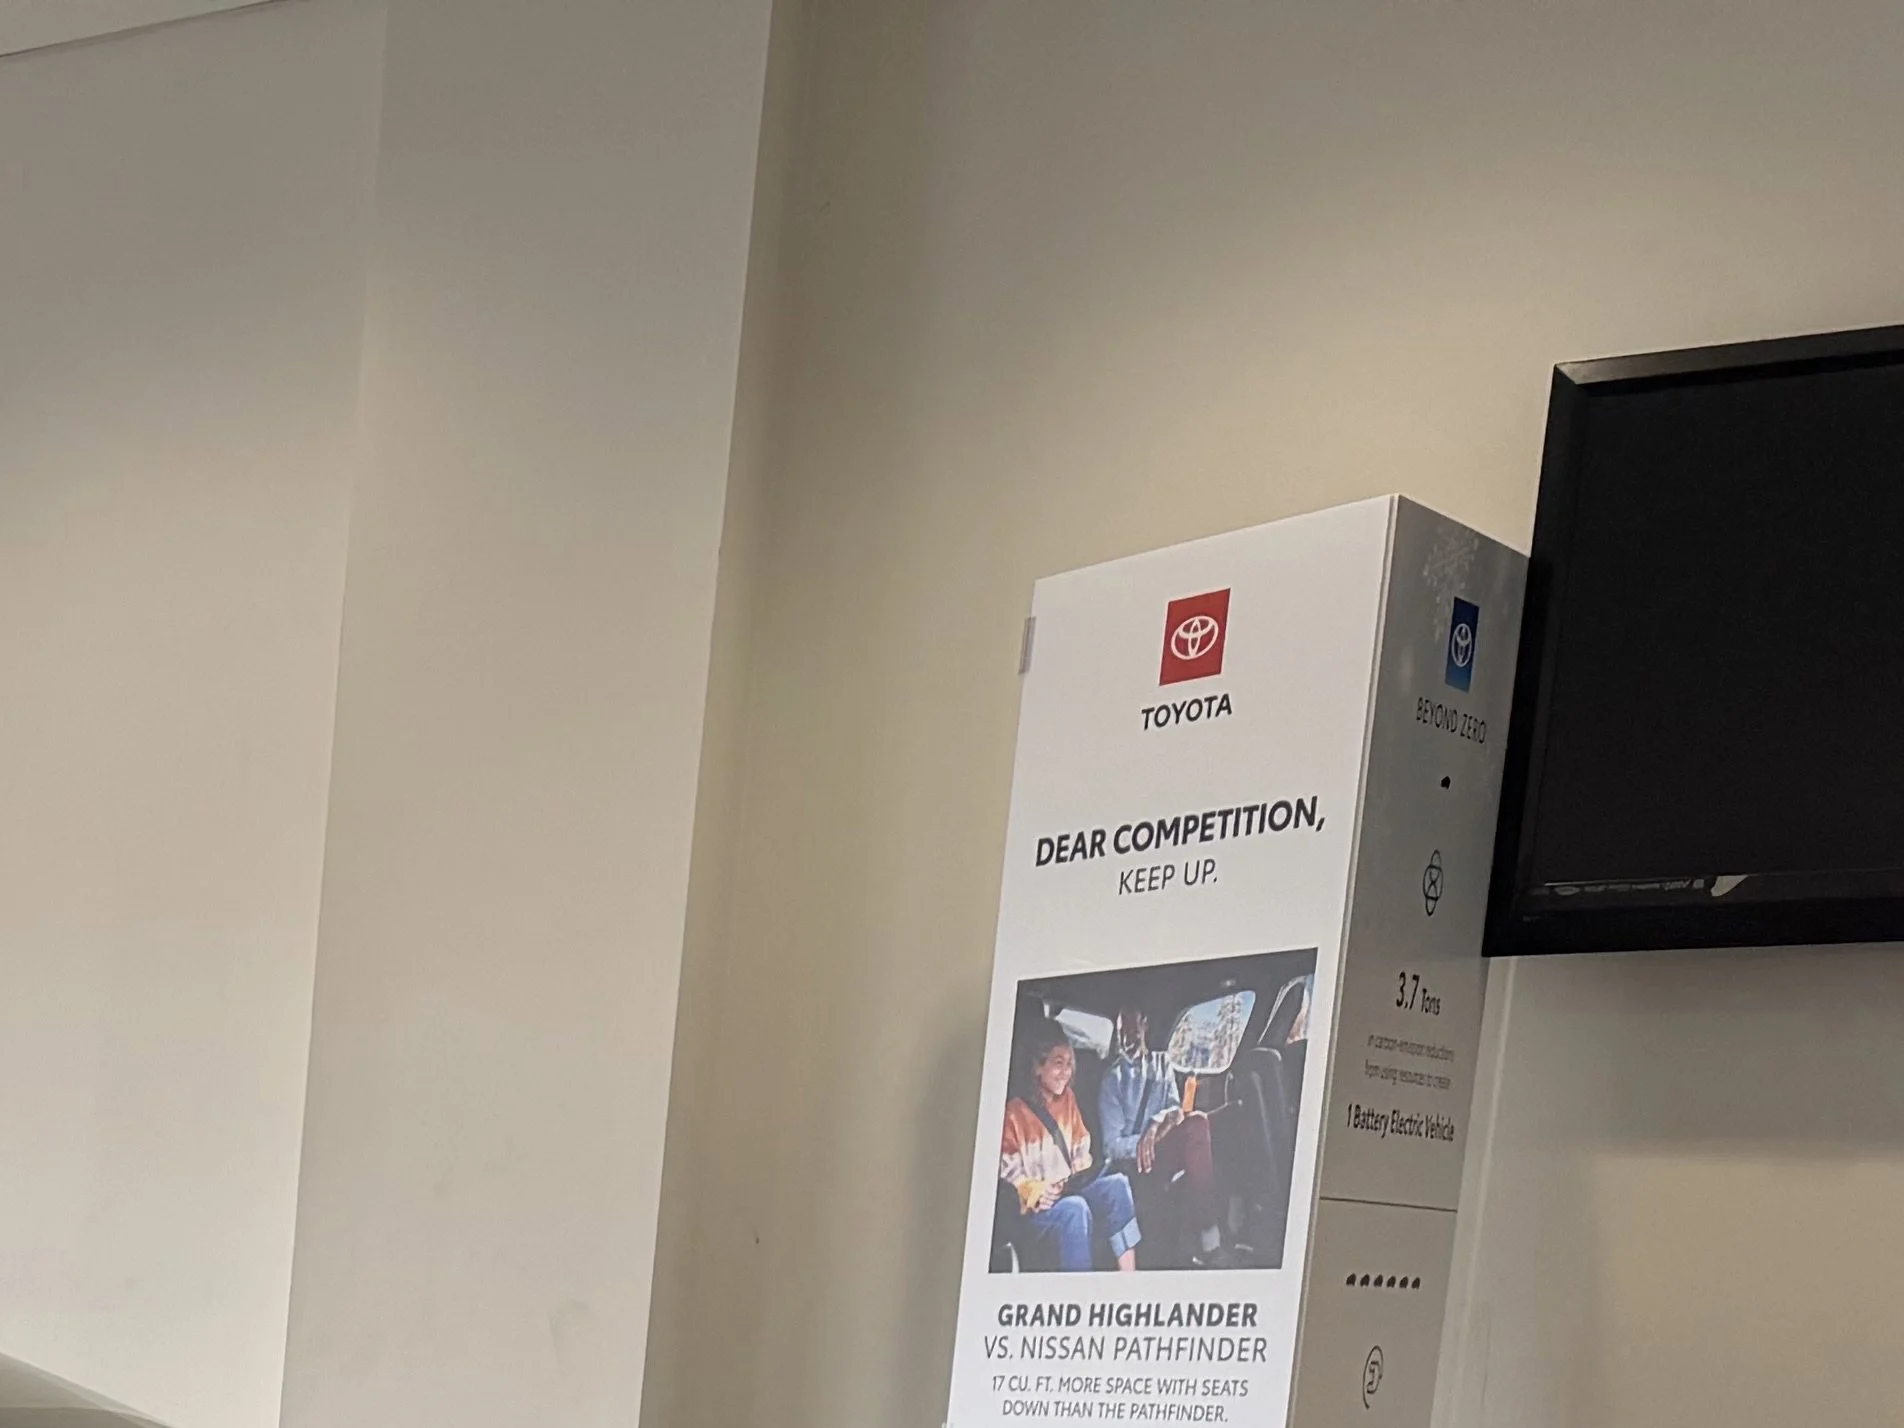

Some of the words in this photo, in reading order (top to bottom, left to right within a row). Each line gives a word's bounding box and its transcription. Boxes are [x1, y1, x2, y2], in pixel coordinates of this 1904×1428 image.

[1141, 693, 1233, 731] TOYOTA
[1416, 696, 1458, 734] BEYOND
[1460, 709, 1487, 745] ZERO
[1035, 828, 1106, 868] DEAR
[1113, 796, 1326, 854] COMPETITION,
[1118, 864, 1176, 895] KEEP
[1183, 858, 1218, 887] UP.
[1396, 971, 1421, 1011] 3.7
[1353, 1104, 1390, 1139] Battery
[1391, 1109, 1424, 1138] Electric
[1425, 1112, 1455, 1142] Vehicle
[997, 1303, 1082, 1327] GRAND
[1088, 1302, 1259, 1328] HIGHLANDER
[984, 1335, 1013, 1360] VS.
[1020, 1335, 1106, 1361] NISSAN
[1113, 1336, 1268, 1363] PATHFINDER
[991, 1375, 1005, 1392] 17
[1008, 1375, 1031, 1393] CU.
[1035, 1376, 1054, 1393] FT.
[1058, 1376, 1101, 1394] MORE
[1105, 1377, 1153, 1395] SPACE
[1157, 1378, 1197, 1396] WITH
[1201, 1379, 1249, 1398] SEATS
[1002, 1399, 1049, 1417] DOWN
[1054, 1400, 1093, 1418] THAN
[1098, 1402, 1125, 1419] THE
[1129, 1403, 1228, 1423] PATHFINDER.
